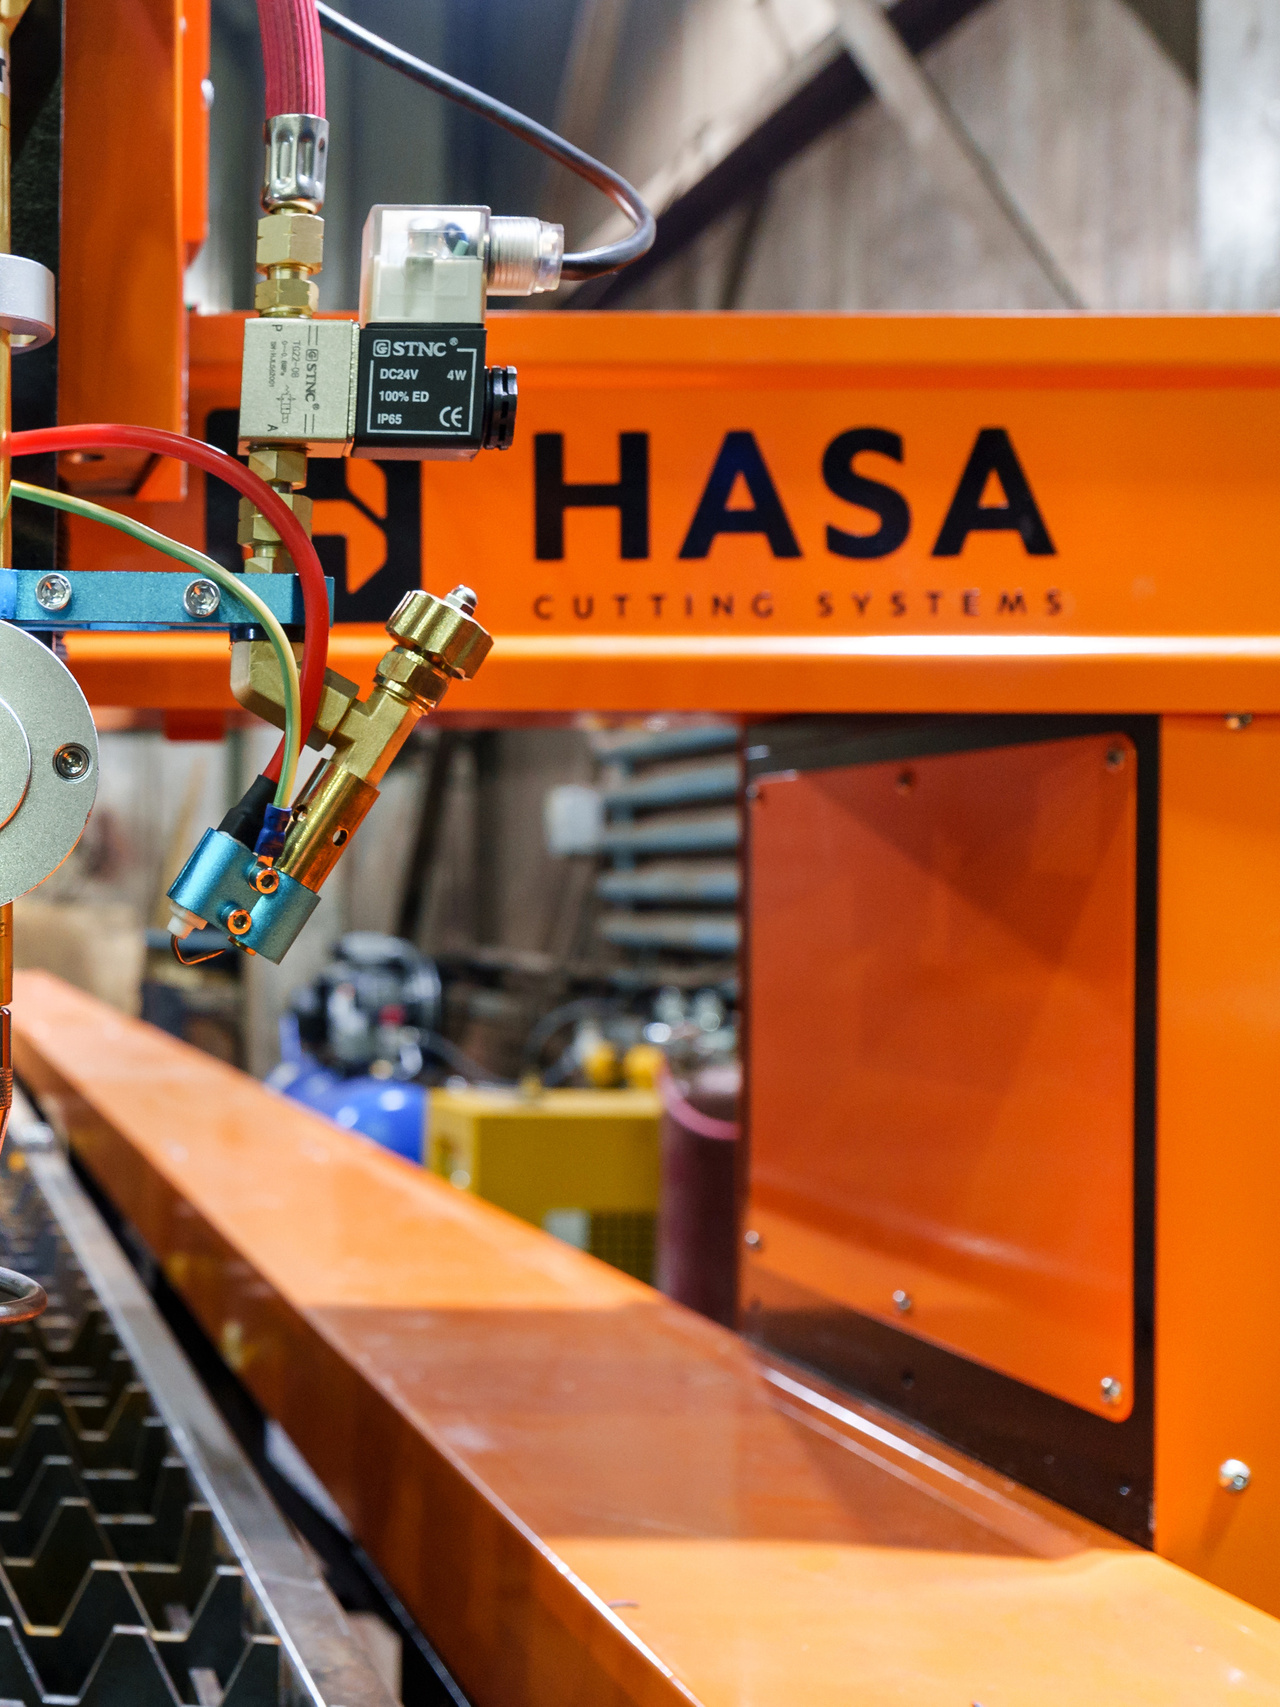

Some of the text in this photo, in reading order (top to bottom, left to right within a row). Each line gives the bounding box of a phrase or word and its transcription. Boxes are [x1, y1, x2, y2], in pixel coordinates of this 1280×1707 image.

[392, 341, 447, 357] STNC
[380, 368, 419, 380] DC24V
[447, 370, 467, 381] 4W
[305, 363, 317, 402] STNC
[379, 391, 430, 402] 100% ED
[377, 413, 403, 425] IP65
[439, 406, 463, 427] CE
[267, 424, 278, 432] A
[533, 427, 1058, 561] HASA
[533, 589, 1063, 620] CUTTING SYSTEMS
